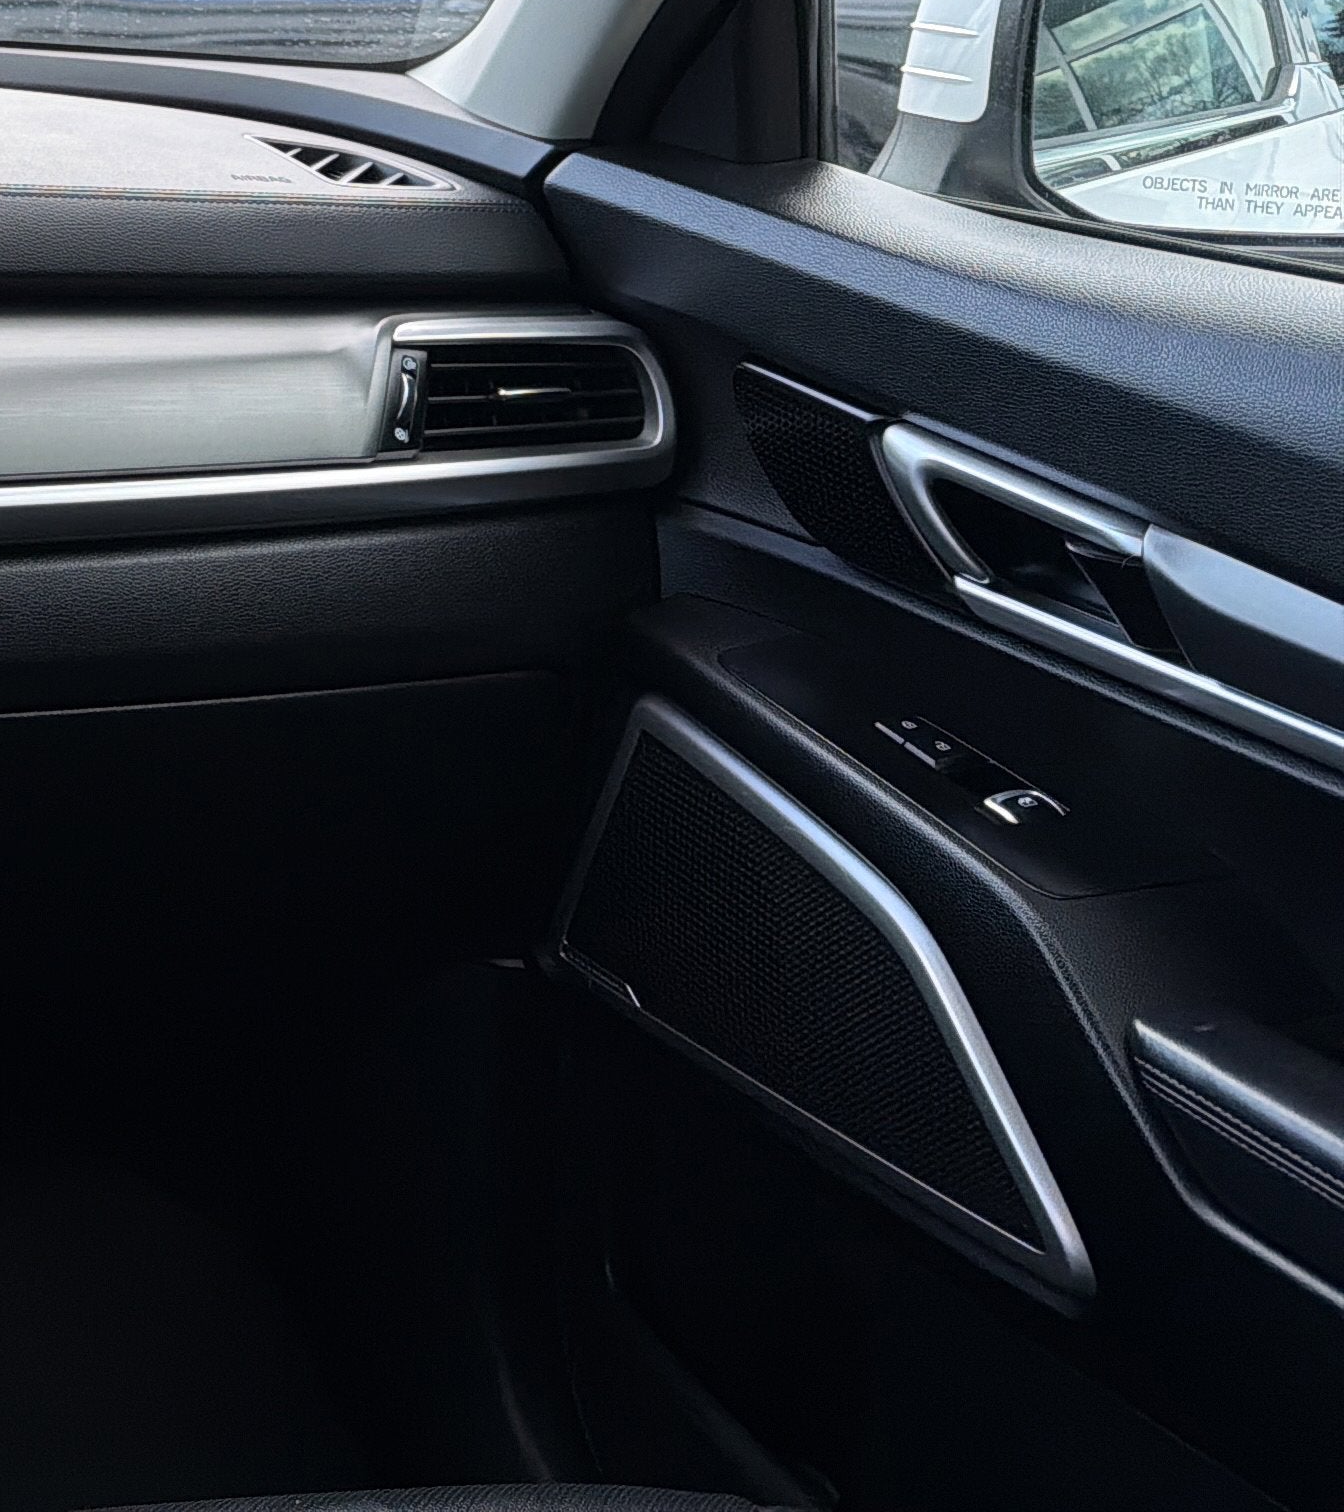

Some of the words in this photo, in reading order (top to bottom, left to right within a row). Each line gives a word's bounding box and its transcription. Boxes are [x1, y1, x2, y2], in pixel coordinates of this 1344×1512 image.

[1142, 175, 1208, 194] OBJECTS
[1219, 181, 1233, 195] IN
[1245, 183, 1300, 199] MIRROR
[1310, 188, 1341, 203] ARE
[1197, 196, 1235, 212] THAN
[1245, 199, 1284, 215] THEY
